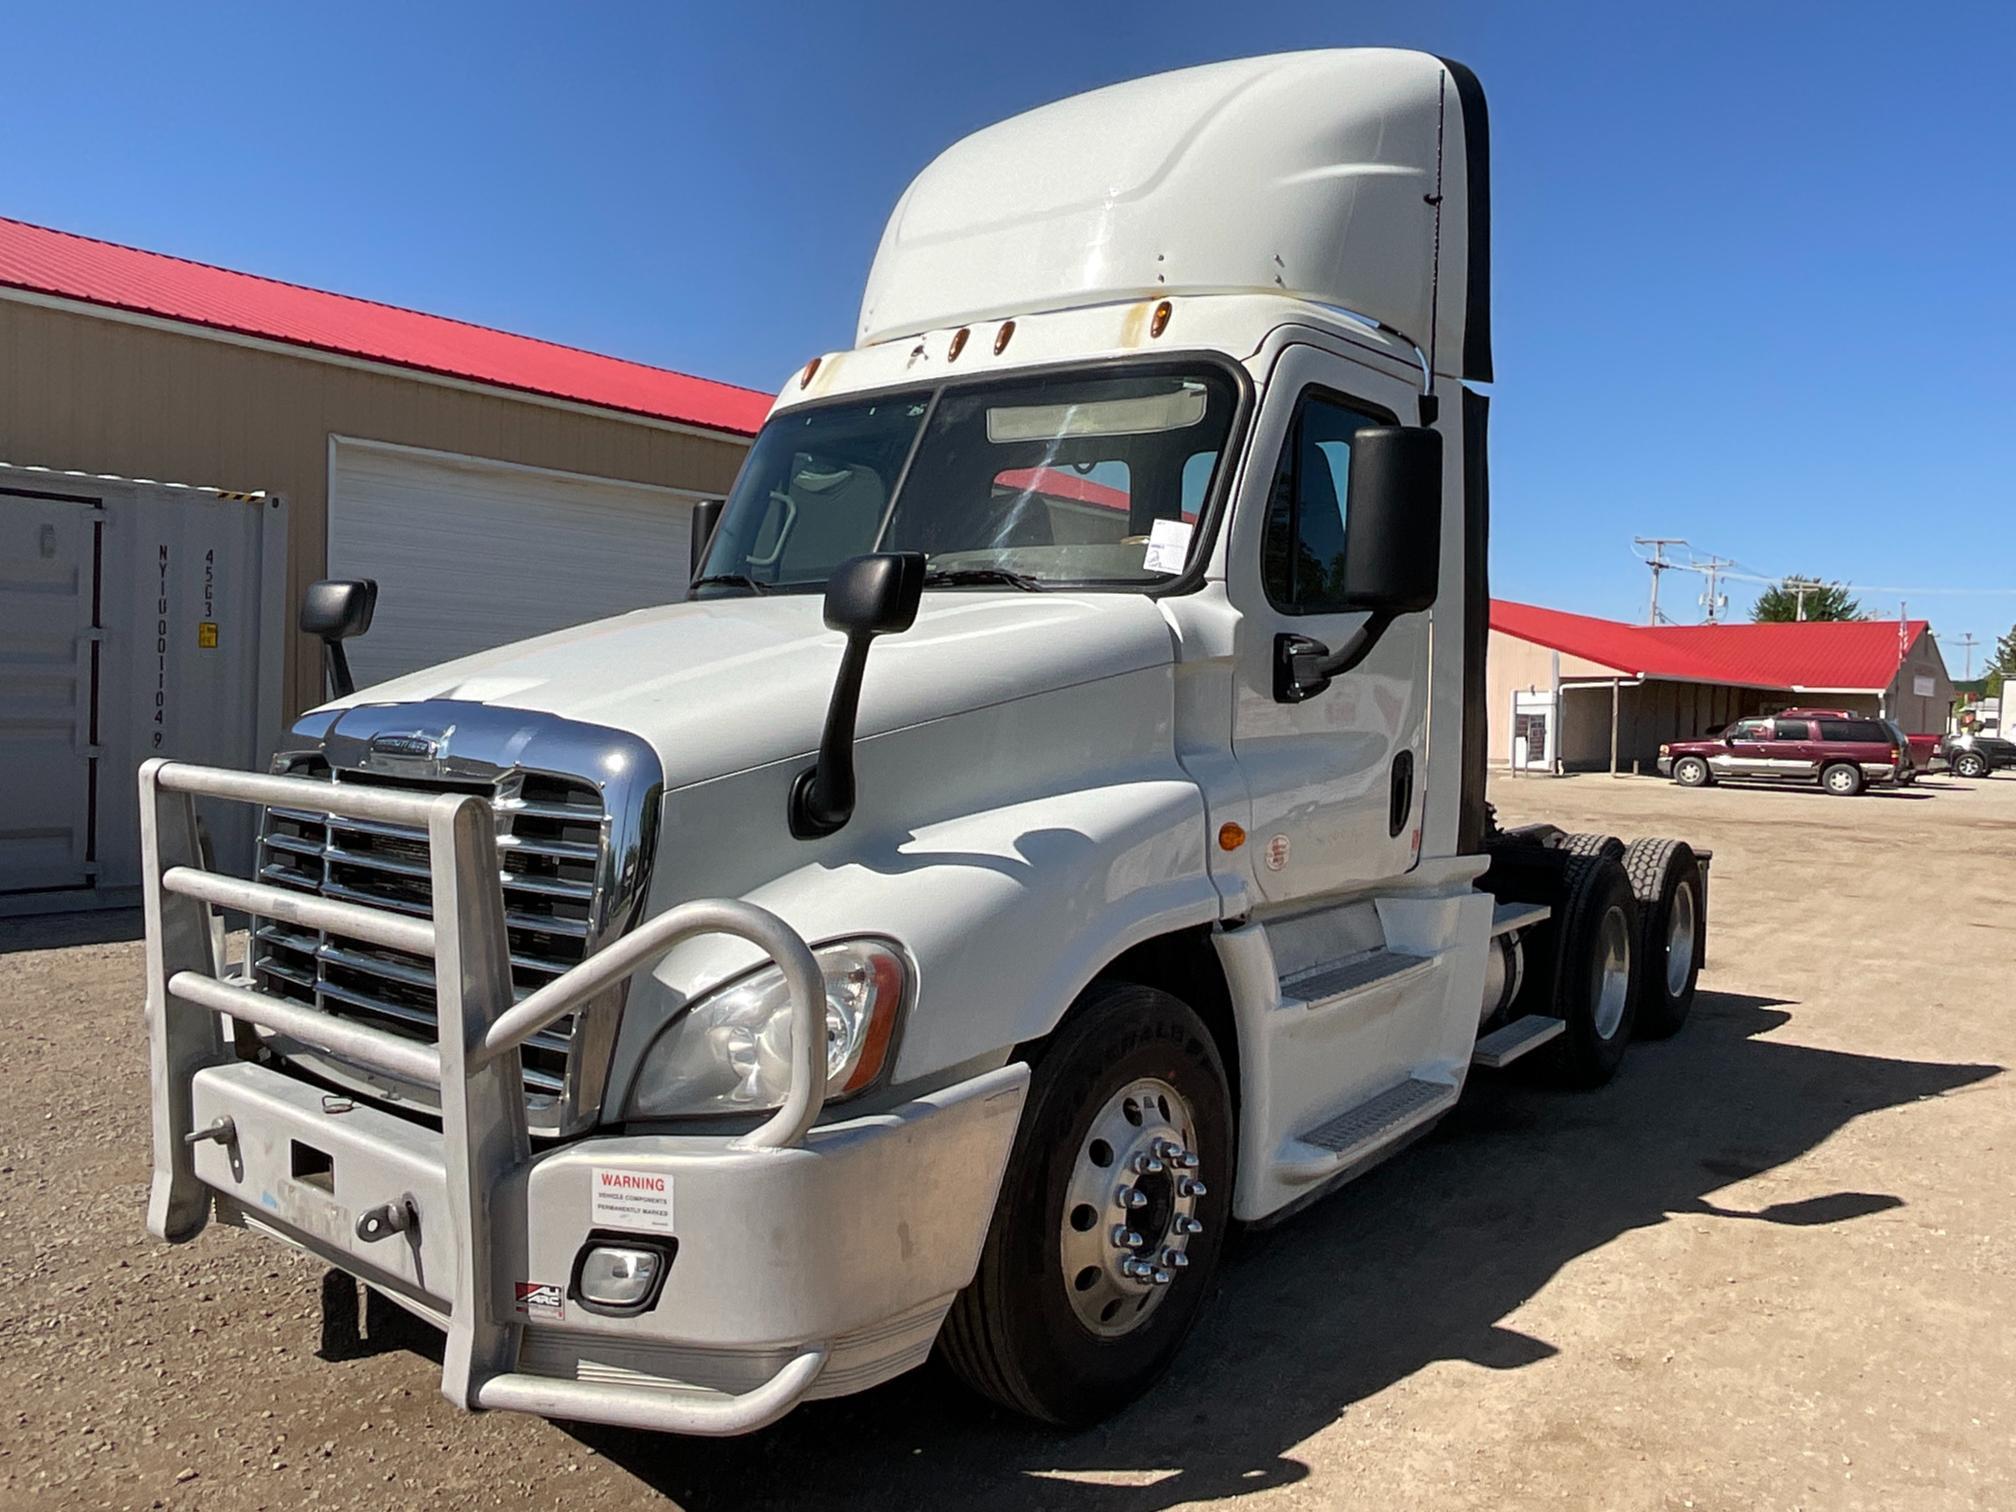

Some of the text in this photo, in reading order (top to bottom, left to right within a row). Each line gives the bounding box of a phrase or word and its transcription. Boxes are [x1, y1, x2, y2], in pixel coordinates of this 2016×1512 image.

[601, 1173, 665, 1191] WARNING
[598, 1192, 667, 1205] VEHICLE COMPONENTS
[597, 1203, 668, 1216] PERMANENTLY MARKED
[528, 1295, 560, 1306] ARC
